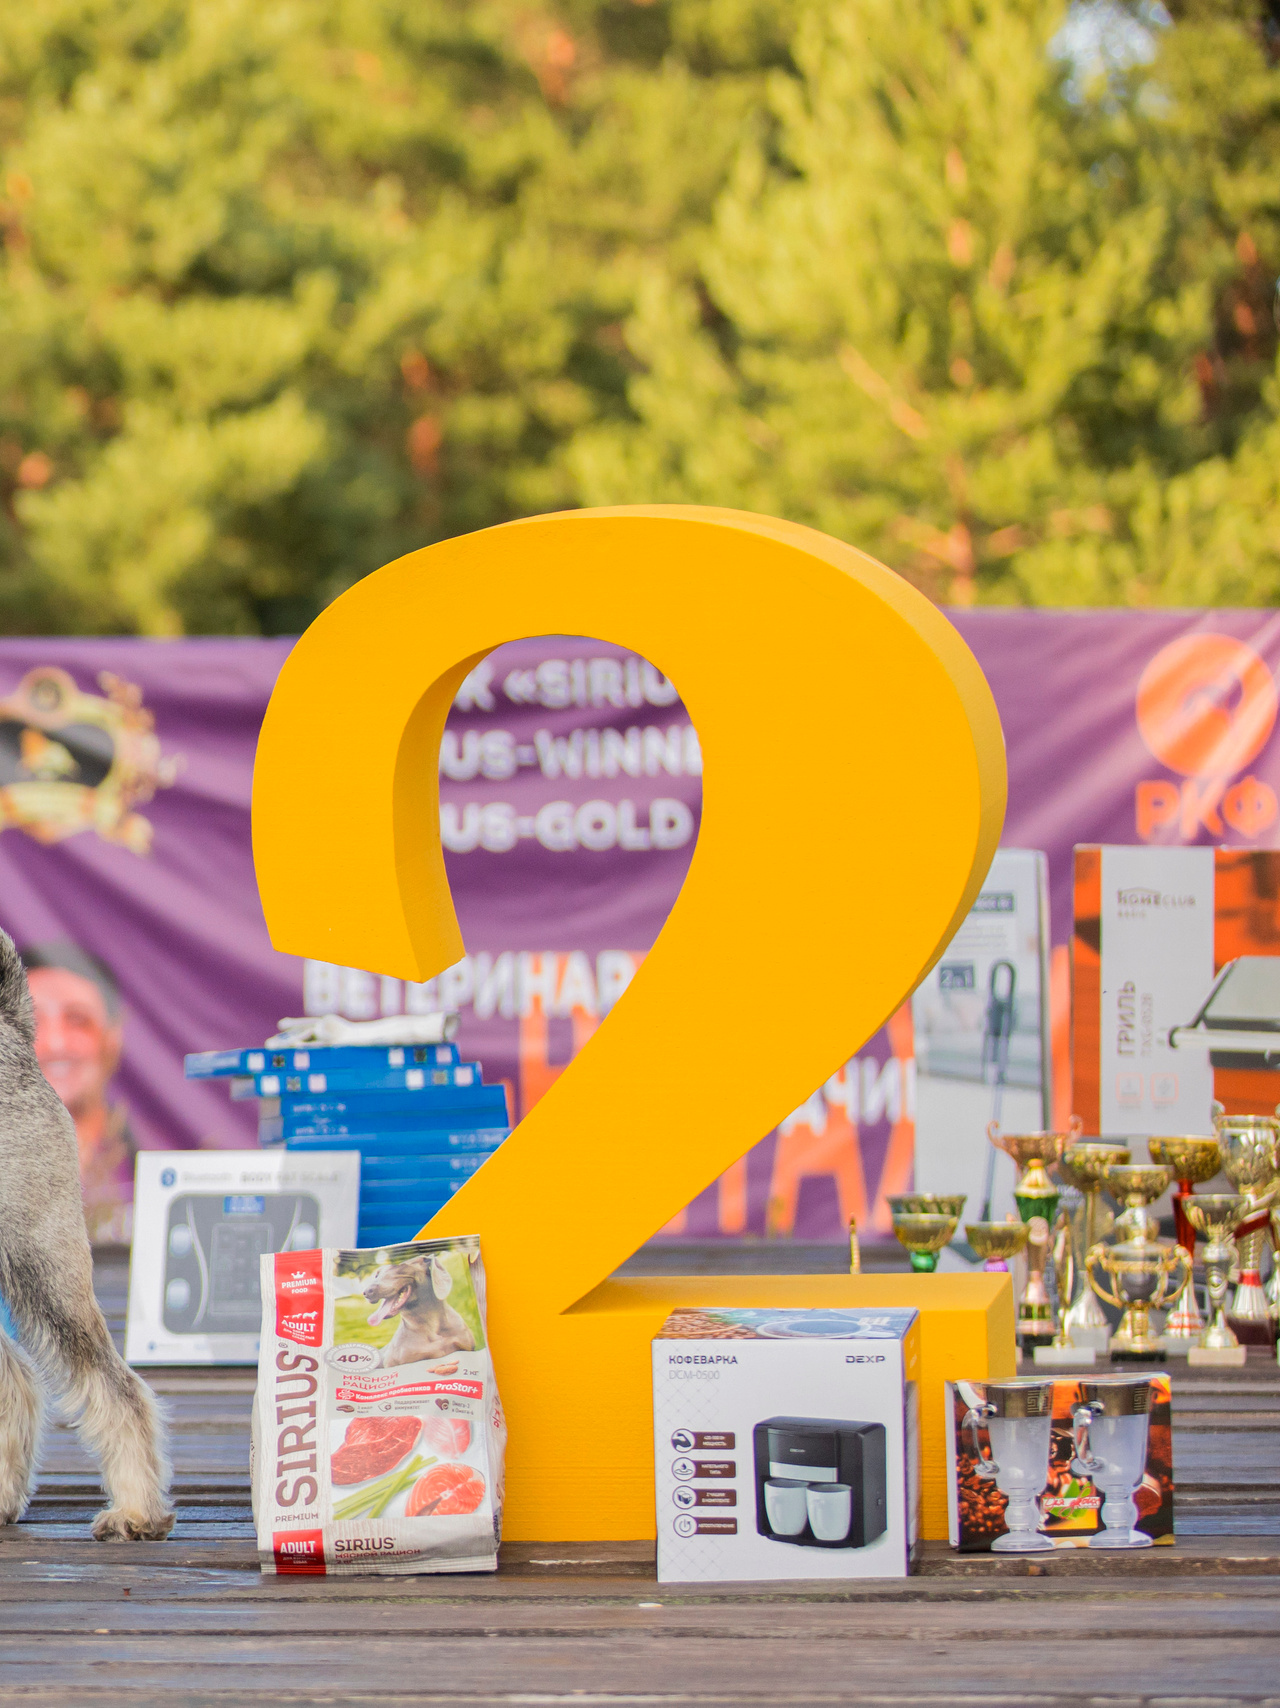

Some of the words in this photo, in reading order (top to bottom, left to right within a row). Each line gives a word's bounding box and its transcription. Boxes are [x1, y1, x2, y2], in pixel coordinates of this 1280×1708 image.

[503, 656, 680, 709] «SIRIU
[439, 723, 703, 780] US-WINN
[1135, 776, 1278, 839] РКФ
[439, 797, 695, 853] US-GOLD
[303, 950, 637, 1020] ВЕТЕРИНАР
[1117, 980, 1136, 1056] ГРИЛЬ
[281, 1278, 317, 1289] PREMIUM
[281, 1319, 316, 1332] ADULT
[336, 1353, 372, 1363] 40%
[669, 1355, 738, 1365] КОФЕВАРКА
[845, 1355, 886, 1364] DEXP
[342, 1371, 399, 1384] МЯСНОЙ
[463, 1368, 469, 1376] 2
[669, 1369, 720, 1380] DCM-0500
[342, 1379, 396, 1391] РАЦИОН
[434, 1382, 478, 1394] ProStor+
[275, 1350, 319, 1508] SIRIUS
[275, 1512, 319, 1523] PREMIUM
[280, 1541, 315, 1554] ADULT
[334, 1537, 394, 1552] SIRIUS
[335, 1550, 378, 1559] МЯСНОЙ
[380, 1548, 421, 1557] РАЦИОН
